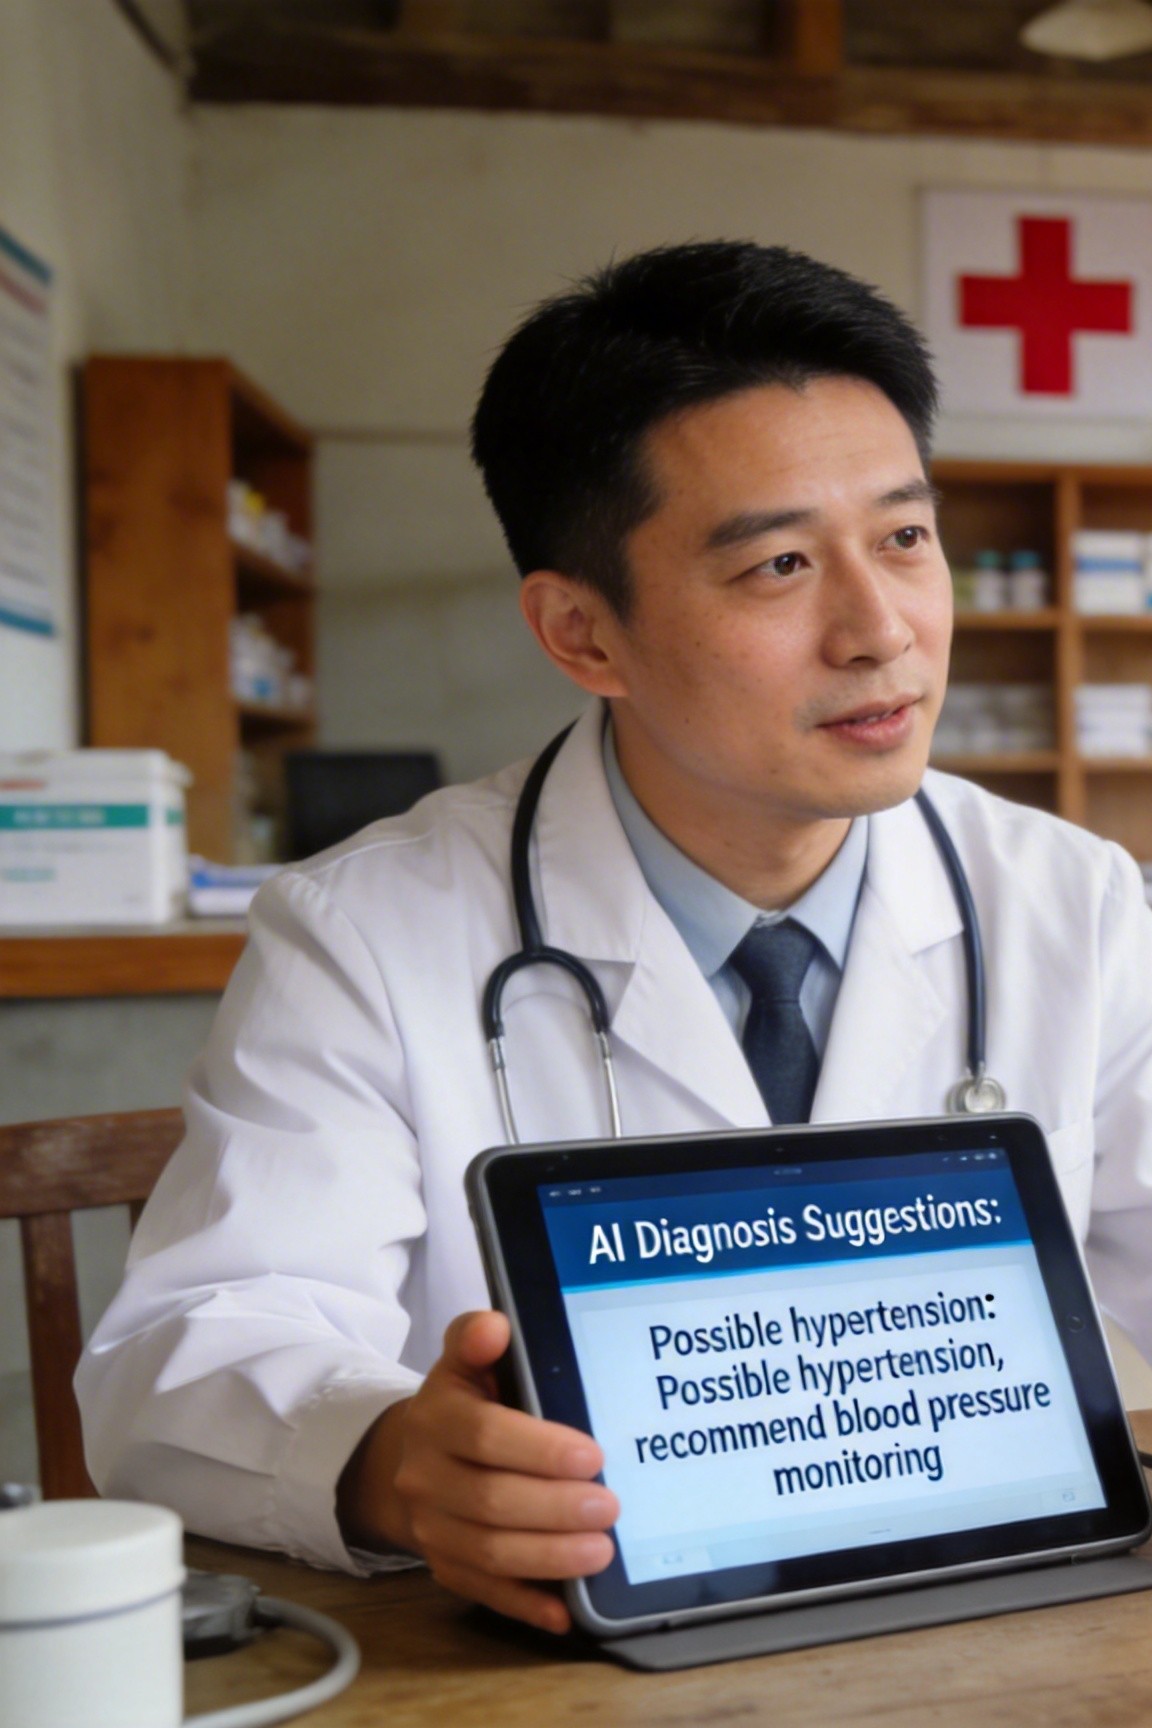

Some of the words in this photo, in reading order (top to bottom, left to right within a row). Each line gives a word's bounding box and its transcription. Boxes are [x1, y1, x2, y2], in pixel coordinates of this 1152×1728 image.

[589, 1222, 625, 1265] AI
[634, 1207, 797, 1263] Diagnosis
[803, 1194, 1001, 1246] Suggestions:
[649, 1311, 783, 1360] Possible
[789, 1292, 996, 1348] hypertension:
[656, 1360, 791, 1410] Possible
[797, 1338, 1004, 1396] hypertension,
[635, 1404, 827, 1463] recommend
[833, 1390, 921, 1436] blood
[928, 1381, 1051, 1432] pressure
[773, 1443, 944, 1496] monitoring
